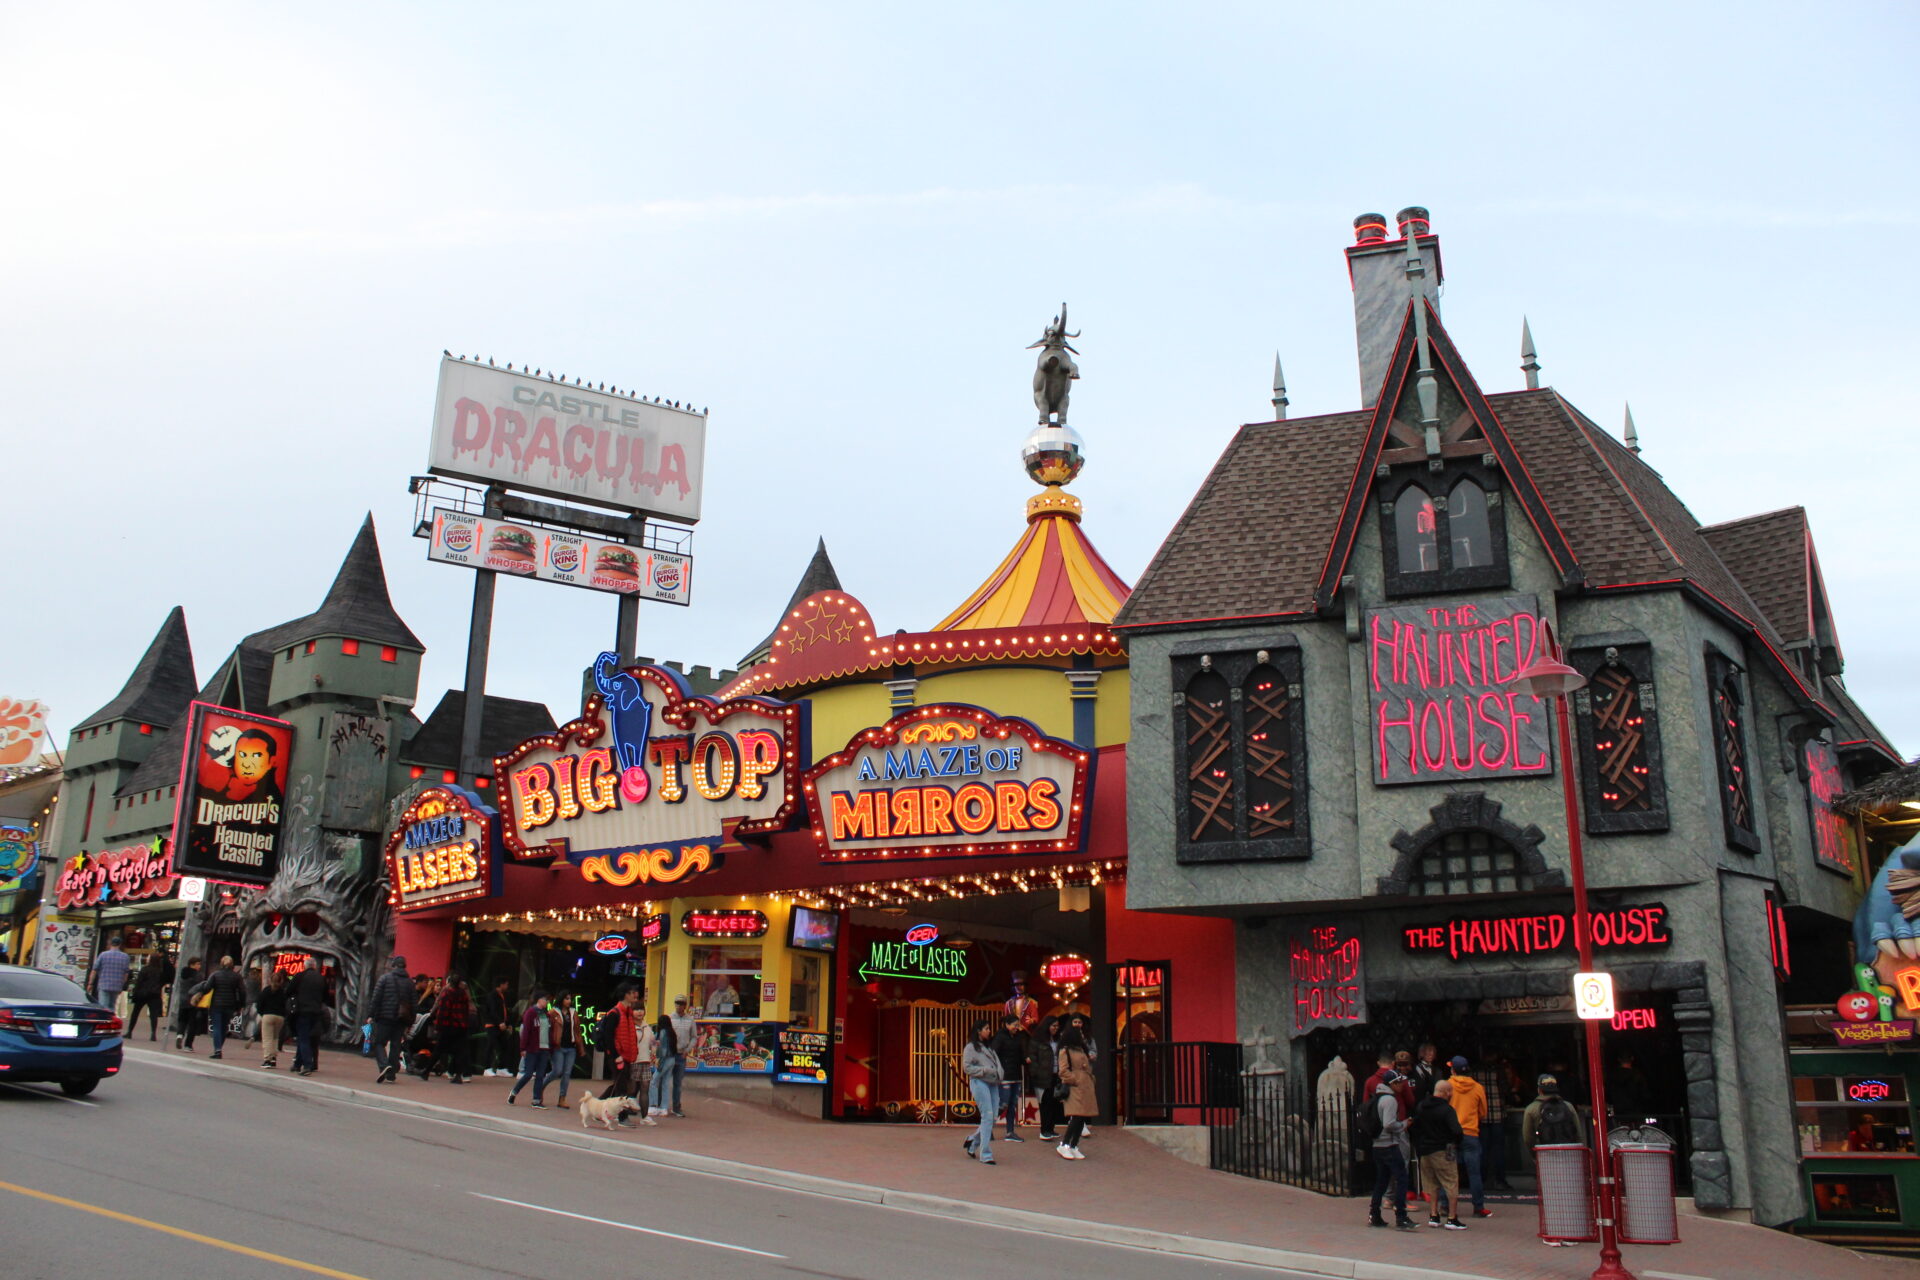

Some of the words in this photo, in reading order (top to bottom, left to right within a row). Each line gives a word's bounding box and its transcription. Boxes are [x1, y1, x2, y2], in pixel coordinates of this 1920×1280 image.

[512, 385, 640, 429] CASTLE
[452, 396, 692, 501] DRACULA
[444, 513, 478, 525] STRAIGHT
[446, 529, 472, 537] BURGER
[446, 535, 472, 544] KING
[551, 534, 583, 545] STRAIGHT
[445, 552, 468, 562] AHEAD
[554, 549, 577, 557] BURGER
[554, 555, 578, 565] KING
[653, 553, 683, 564] STRAIGHT
[486, 556, 536, 572] WHOPPER
[656, 568, 678, 576] BURGER
[553, 572, 575, 582] AHEAD
[592, 576, 639, 591] WHOPPER
[656, 574, 679, 584] KING
[655, 590, 676, 600] AHEAD
[1426, 604, 1479, 627] THE
[1371, 613, 1537, 692] HAUNTED
[330, 716, 388, 761] THRILLER
[1378, 691, 1547, 779] HOUSE
[856, 756, 878, 781] A
[882, 744, 981, 780] MAZE
[984, 747, 1022, 772] OF
[512, 747, 618, 831] BIG
[648, 729, 782, 803] TOP
[213, 825, 274, 851] Haunted
[404, 830, 412, 849] A
[412, 816, 448, 848] MAZE
[448, 816, 463, 838] OF
[219, 842, 264, 867] Castle
[62, 868, 93, 900] Gags
[109, 850, 165, 894] Giggles
[396, 840, 478, 894] LASERS
[692, 917, 757, 930] TICKETS
[908, 927, 938, 942] OPEN
[1311, 927, 1338, 949] THE
[1405, 927, 1445, 949] THE
[1449, 914, 1565, 960] HAUNTED
[597, 938, 627, 951] OPEN
[871, 941, 909, 971] MAZE
[909, 949, 918, 964] OF
[919, 945, 967, 976] LASERS
[1290, 937, 1360, 983] HAUNTED
[1050, 963, 1084, 978] ENTER
[585, 1006, 595, 1019] OF
[1294, 984, 1359, 1030] HOUSE
[1611, 1008, 1657, 1031] OPEN
[1833, 1023, 1911, 1040] VeggieTales
[793, 1055, 813, 1068] BIG
[1849, 1084, 1889, 1098] OPEN
